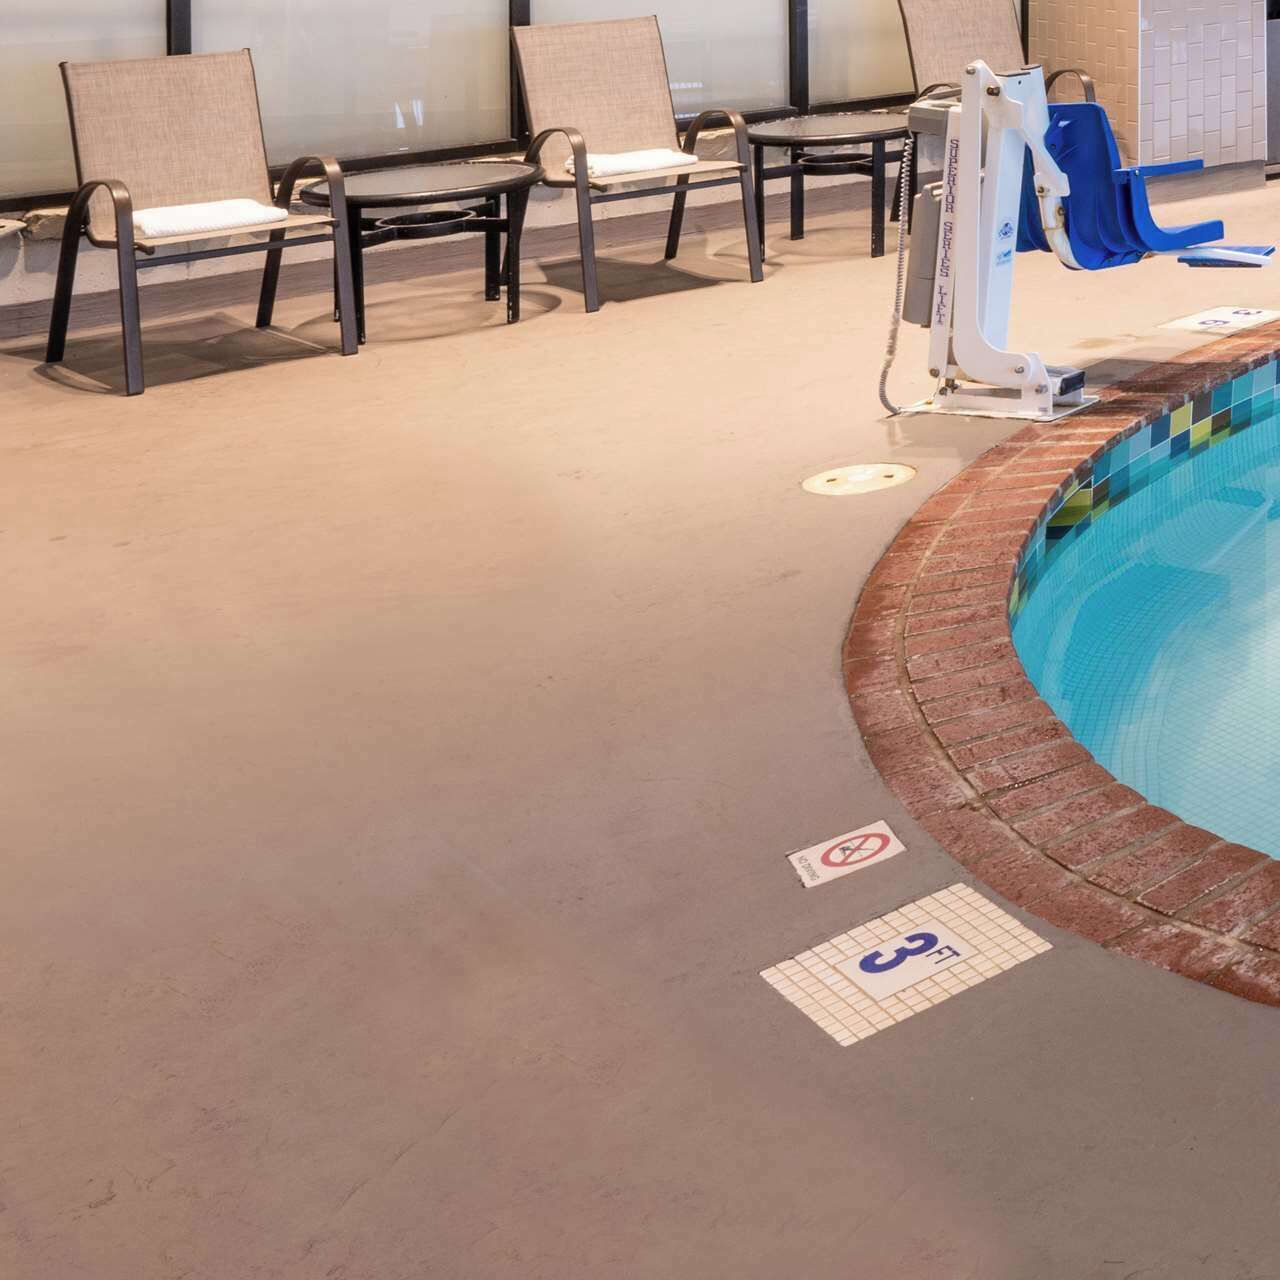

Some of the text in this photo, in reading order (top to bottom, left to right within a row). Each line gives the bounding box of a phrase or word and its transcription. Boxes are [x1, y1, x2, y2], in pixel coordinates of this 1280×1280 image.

[936, 139, 960, 325] SUPERIOR SERIES LIFT
[859, 932, 961, 974] 3 FT
